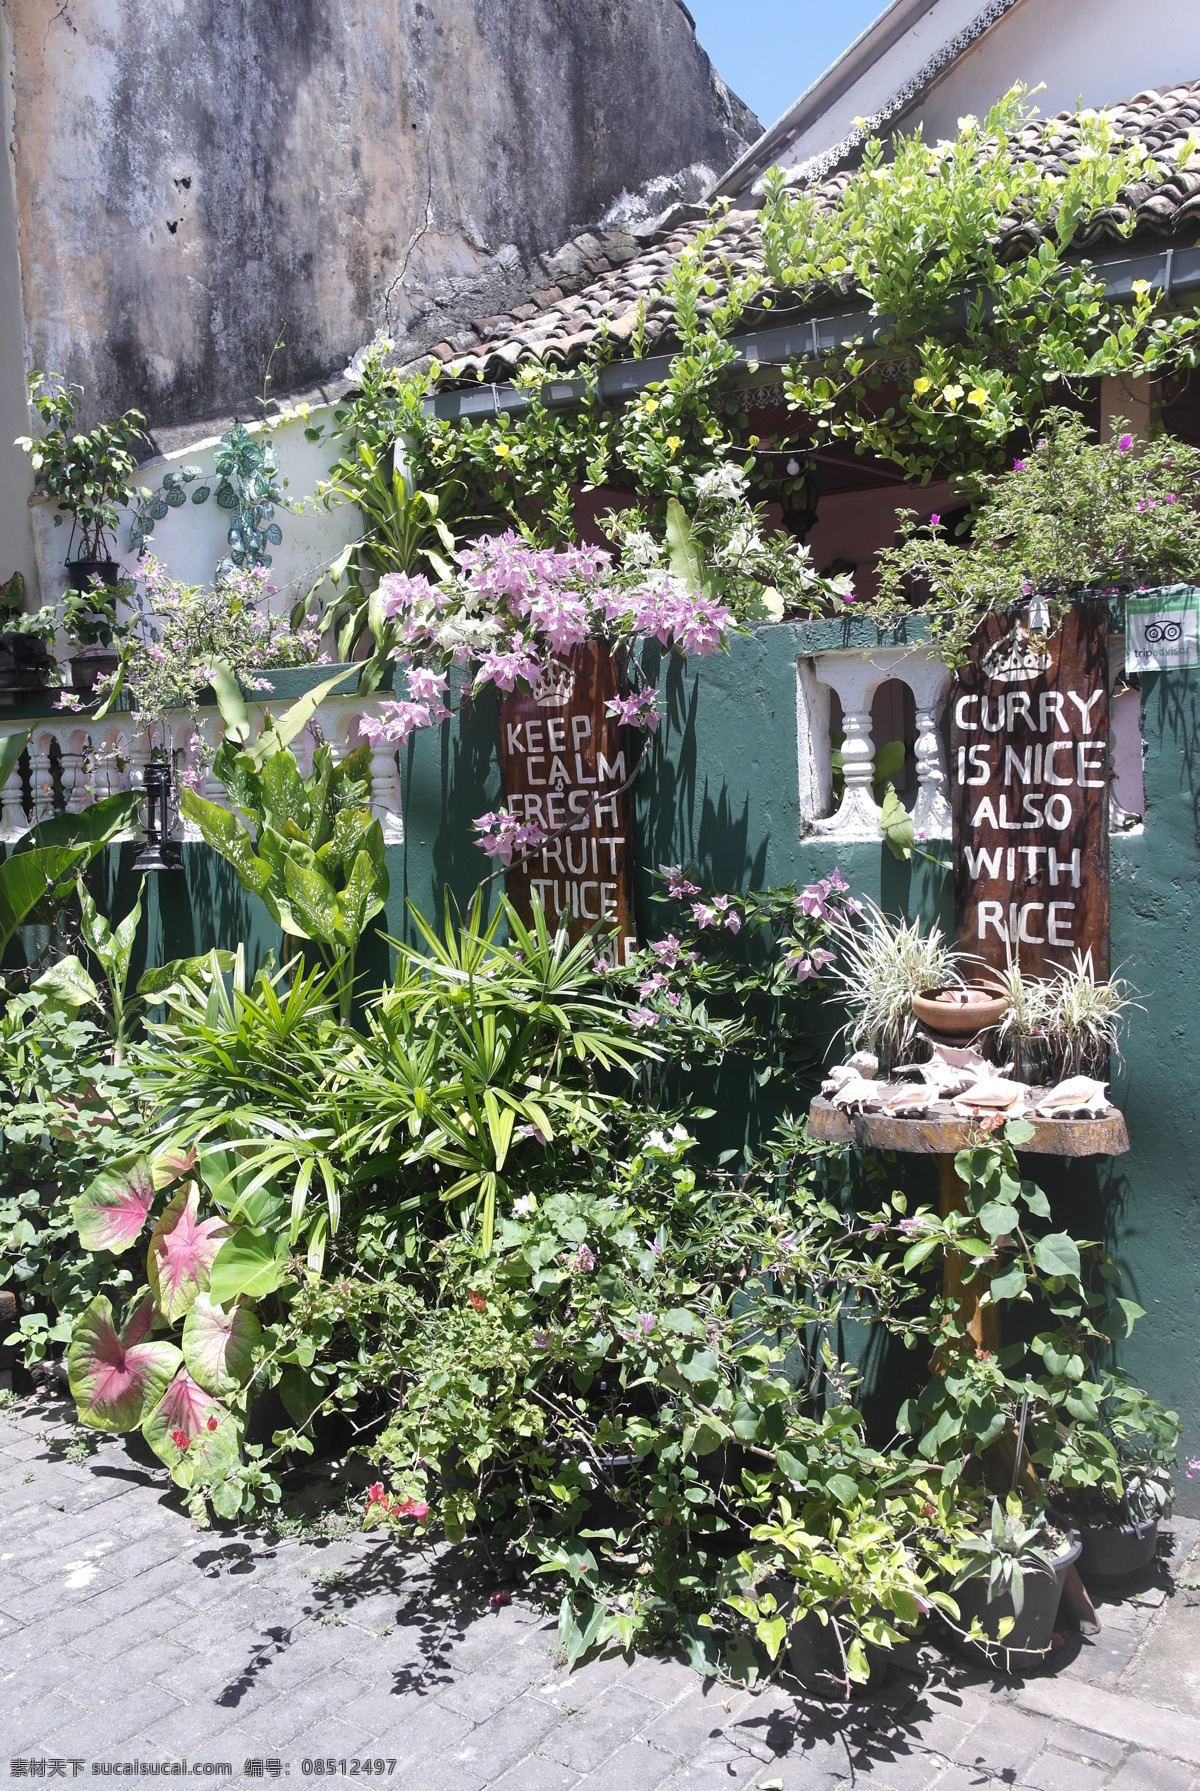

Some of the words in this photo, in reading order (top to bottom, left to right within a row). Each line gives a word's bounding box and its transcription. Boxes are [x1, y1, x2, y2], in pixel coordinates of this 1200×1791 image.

[1134, 646, 1190, 659] tripadvisor
[955, 689, 1104, 734] CURRY
[506, 715, 591, 755] KEEP
[527, 750, 627, 785] CALM
[957, 744, 991, 786] IS
[1004, 741, 1106, 788] NICE
[507, 789, 619, 831] FRESH
[970, 793, 1072, 831] ALSO
[964, 846, 1081, 888] WITH
[978, 901, 1075, 947] RICE
